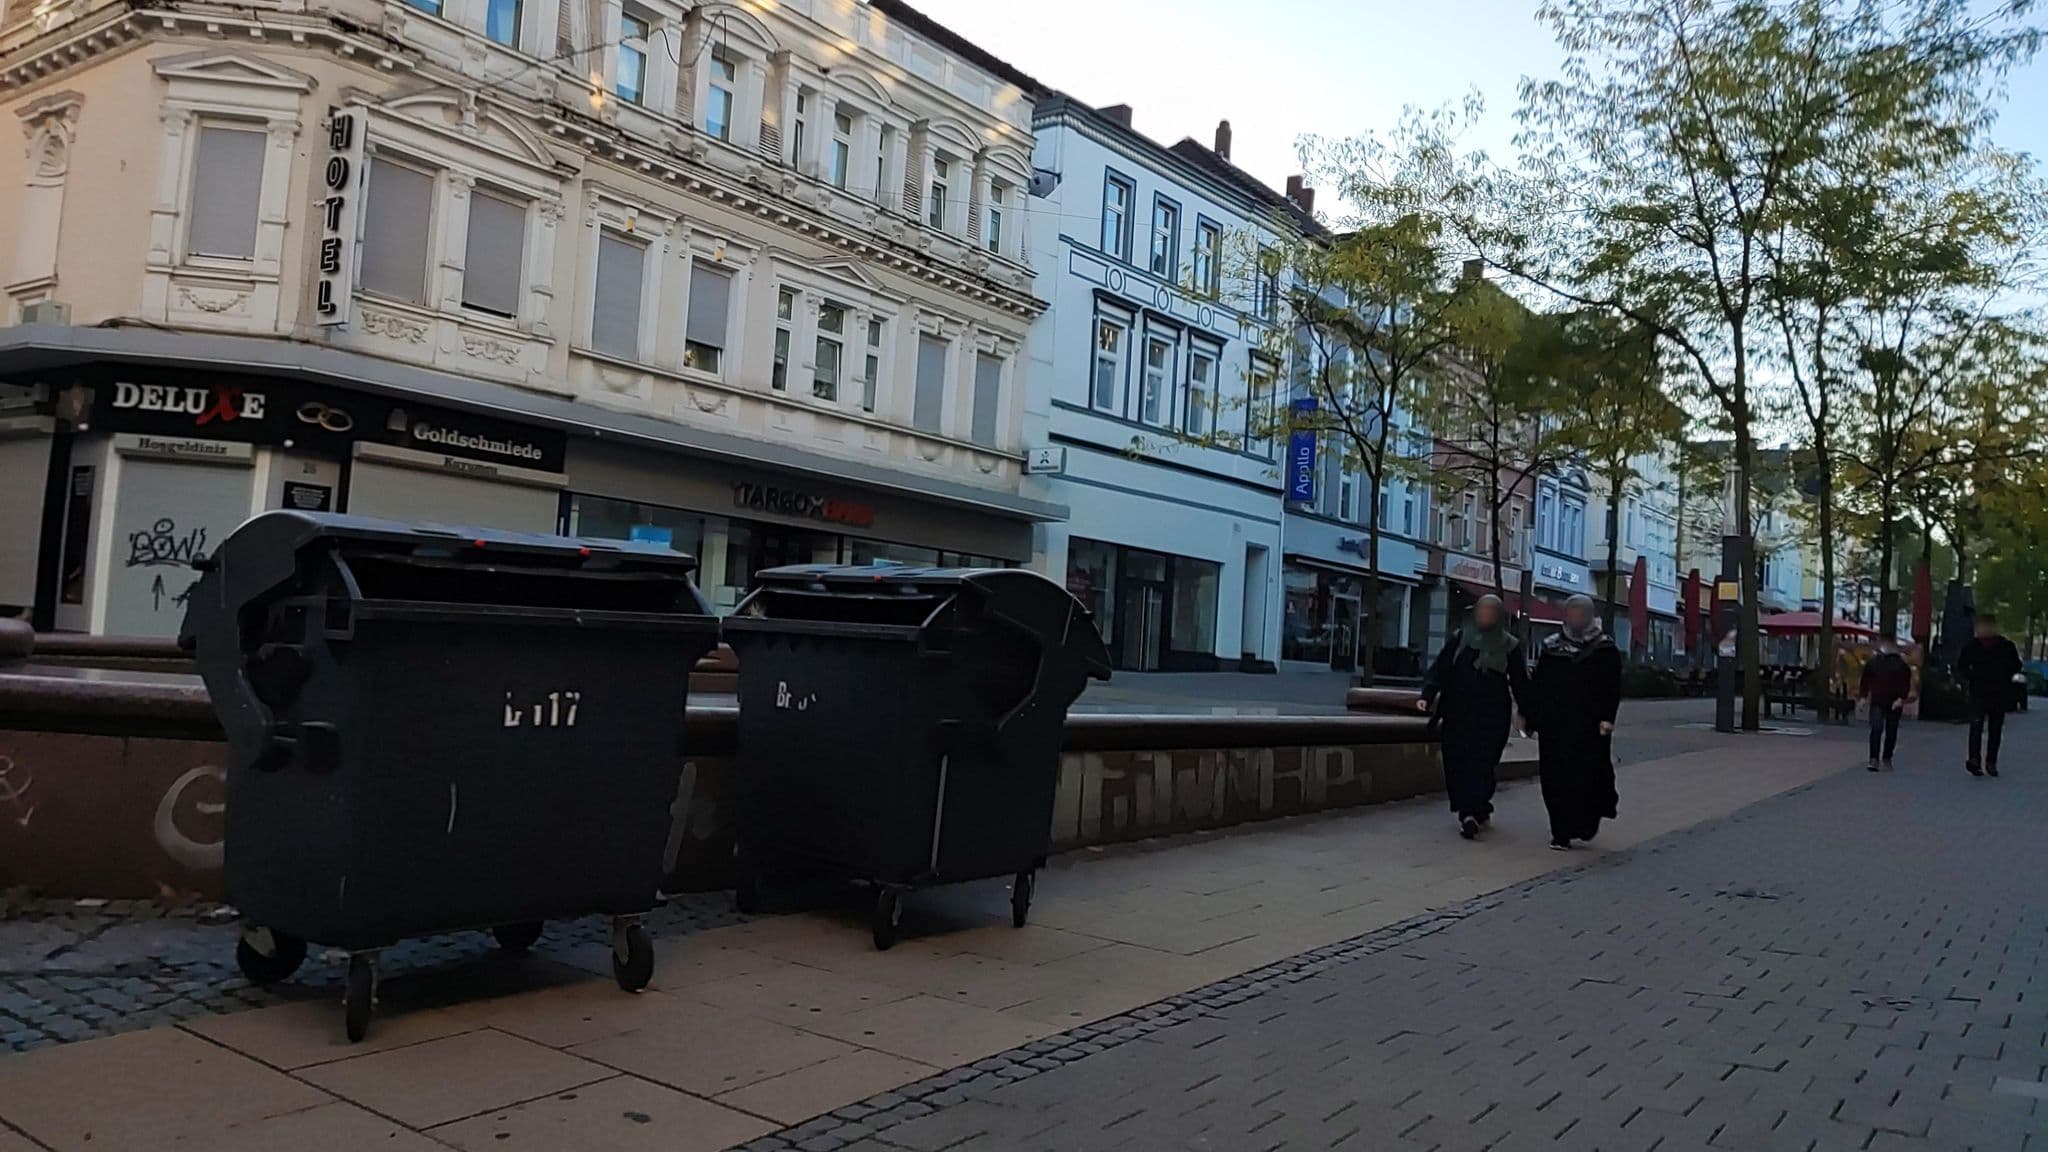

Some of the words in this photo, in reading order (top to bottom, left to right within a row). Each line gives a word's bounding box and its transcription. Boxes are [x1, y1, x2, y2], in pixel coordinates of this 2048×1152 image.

[316, 114, 353, 315] HOTEL
[112, 382, 266, 425] DELUXE
[413, 422, 543, 460] Goldschmiede
